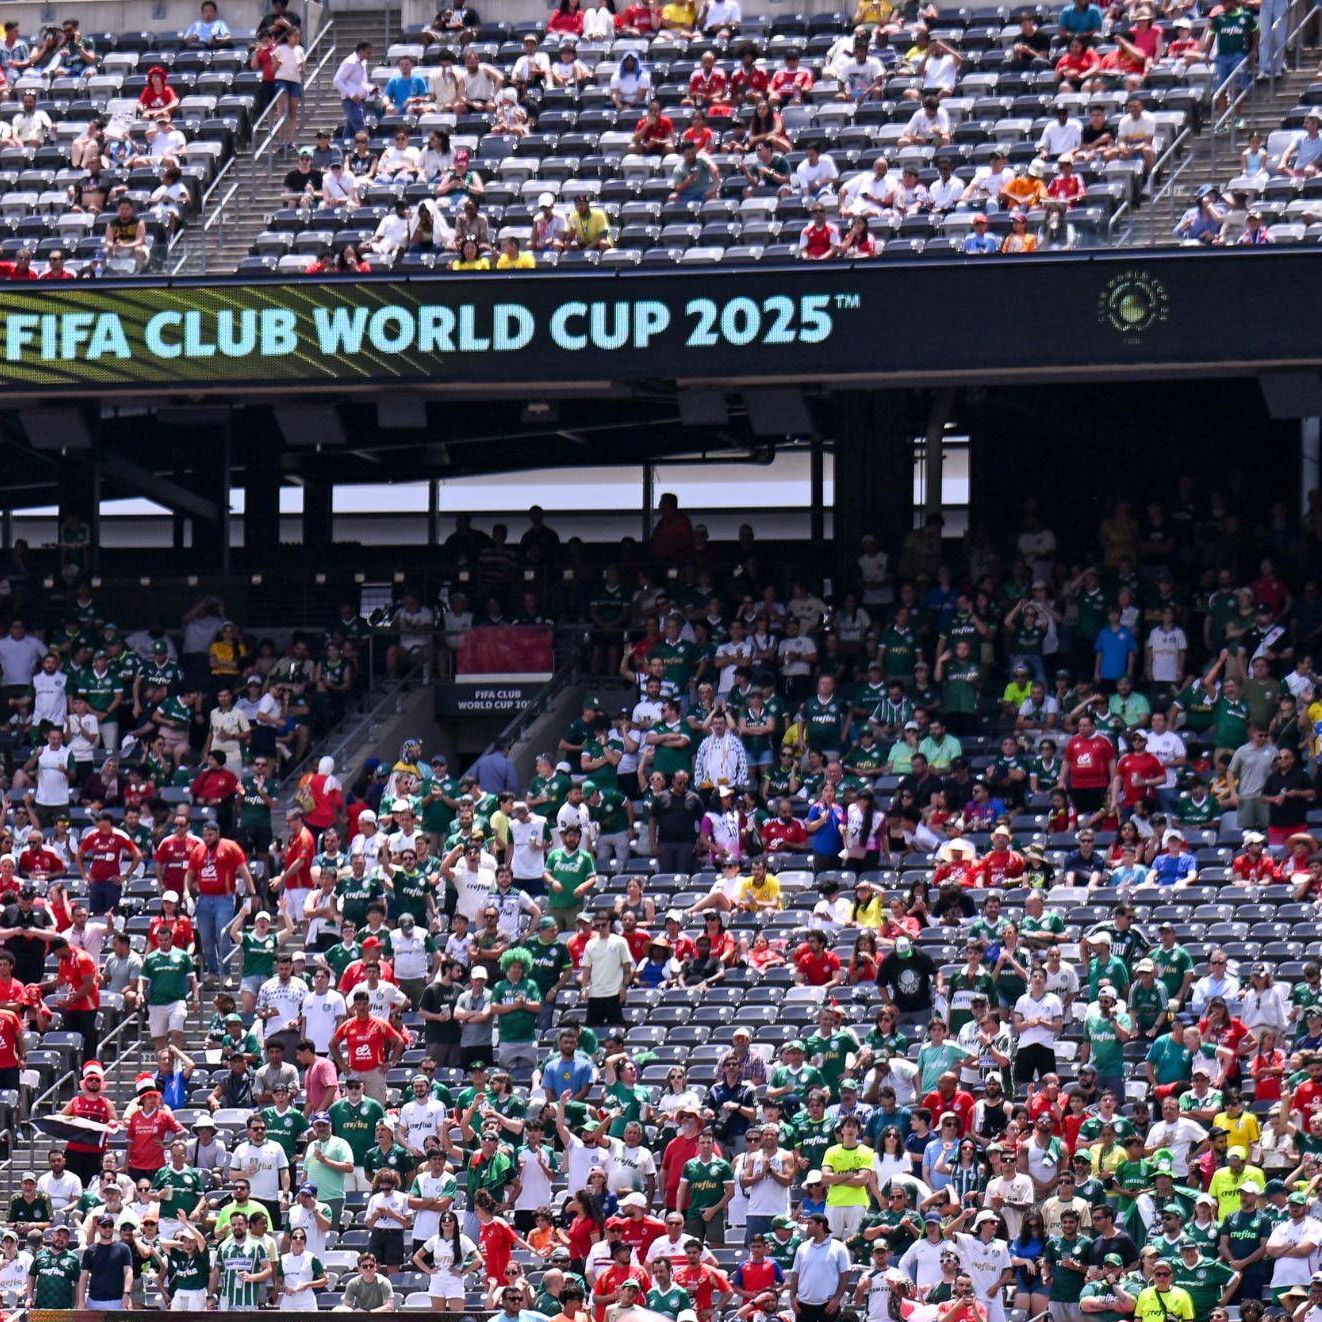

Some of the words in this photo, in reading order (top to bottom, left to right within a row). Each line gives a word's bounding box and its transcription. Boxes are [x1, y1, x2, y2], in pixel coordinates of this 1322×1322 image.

[5, 312, 131, 362] FIFA
[144, 308, 298, 358] CLUB
[312, 302, 535, 354] WORLD
[549, 299, 671, 350] CUP
[475, 690, 495, 699] FIFA
[496, 690, 522, 699] CLUB
[458, 701, 493, 710] WORLD
[494, 701, 514, 709] CUP
[467, 882, 491, 890] crefisa
[403, 888, 425, 897] crefisa
[343, 1120, 368, 1128] crefisa
[803, 1137, 828, 1145] crefisa
[692, 1181, 717, 1189] crefisa
[1230, 1231, 1256, 1239] crefisa
